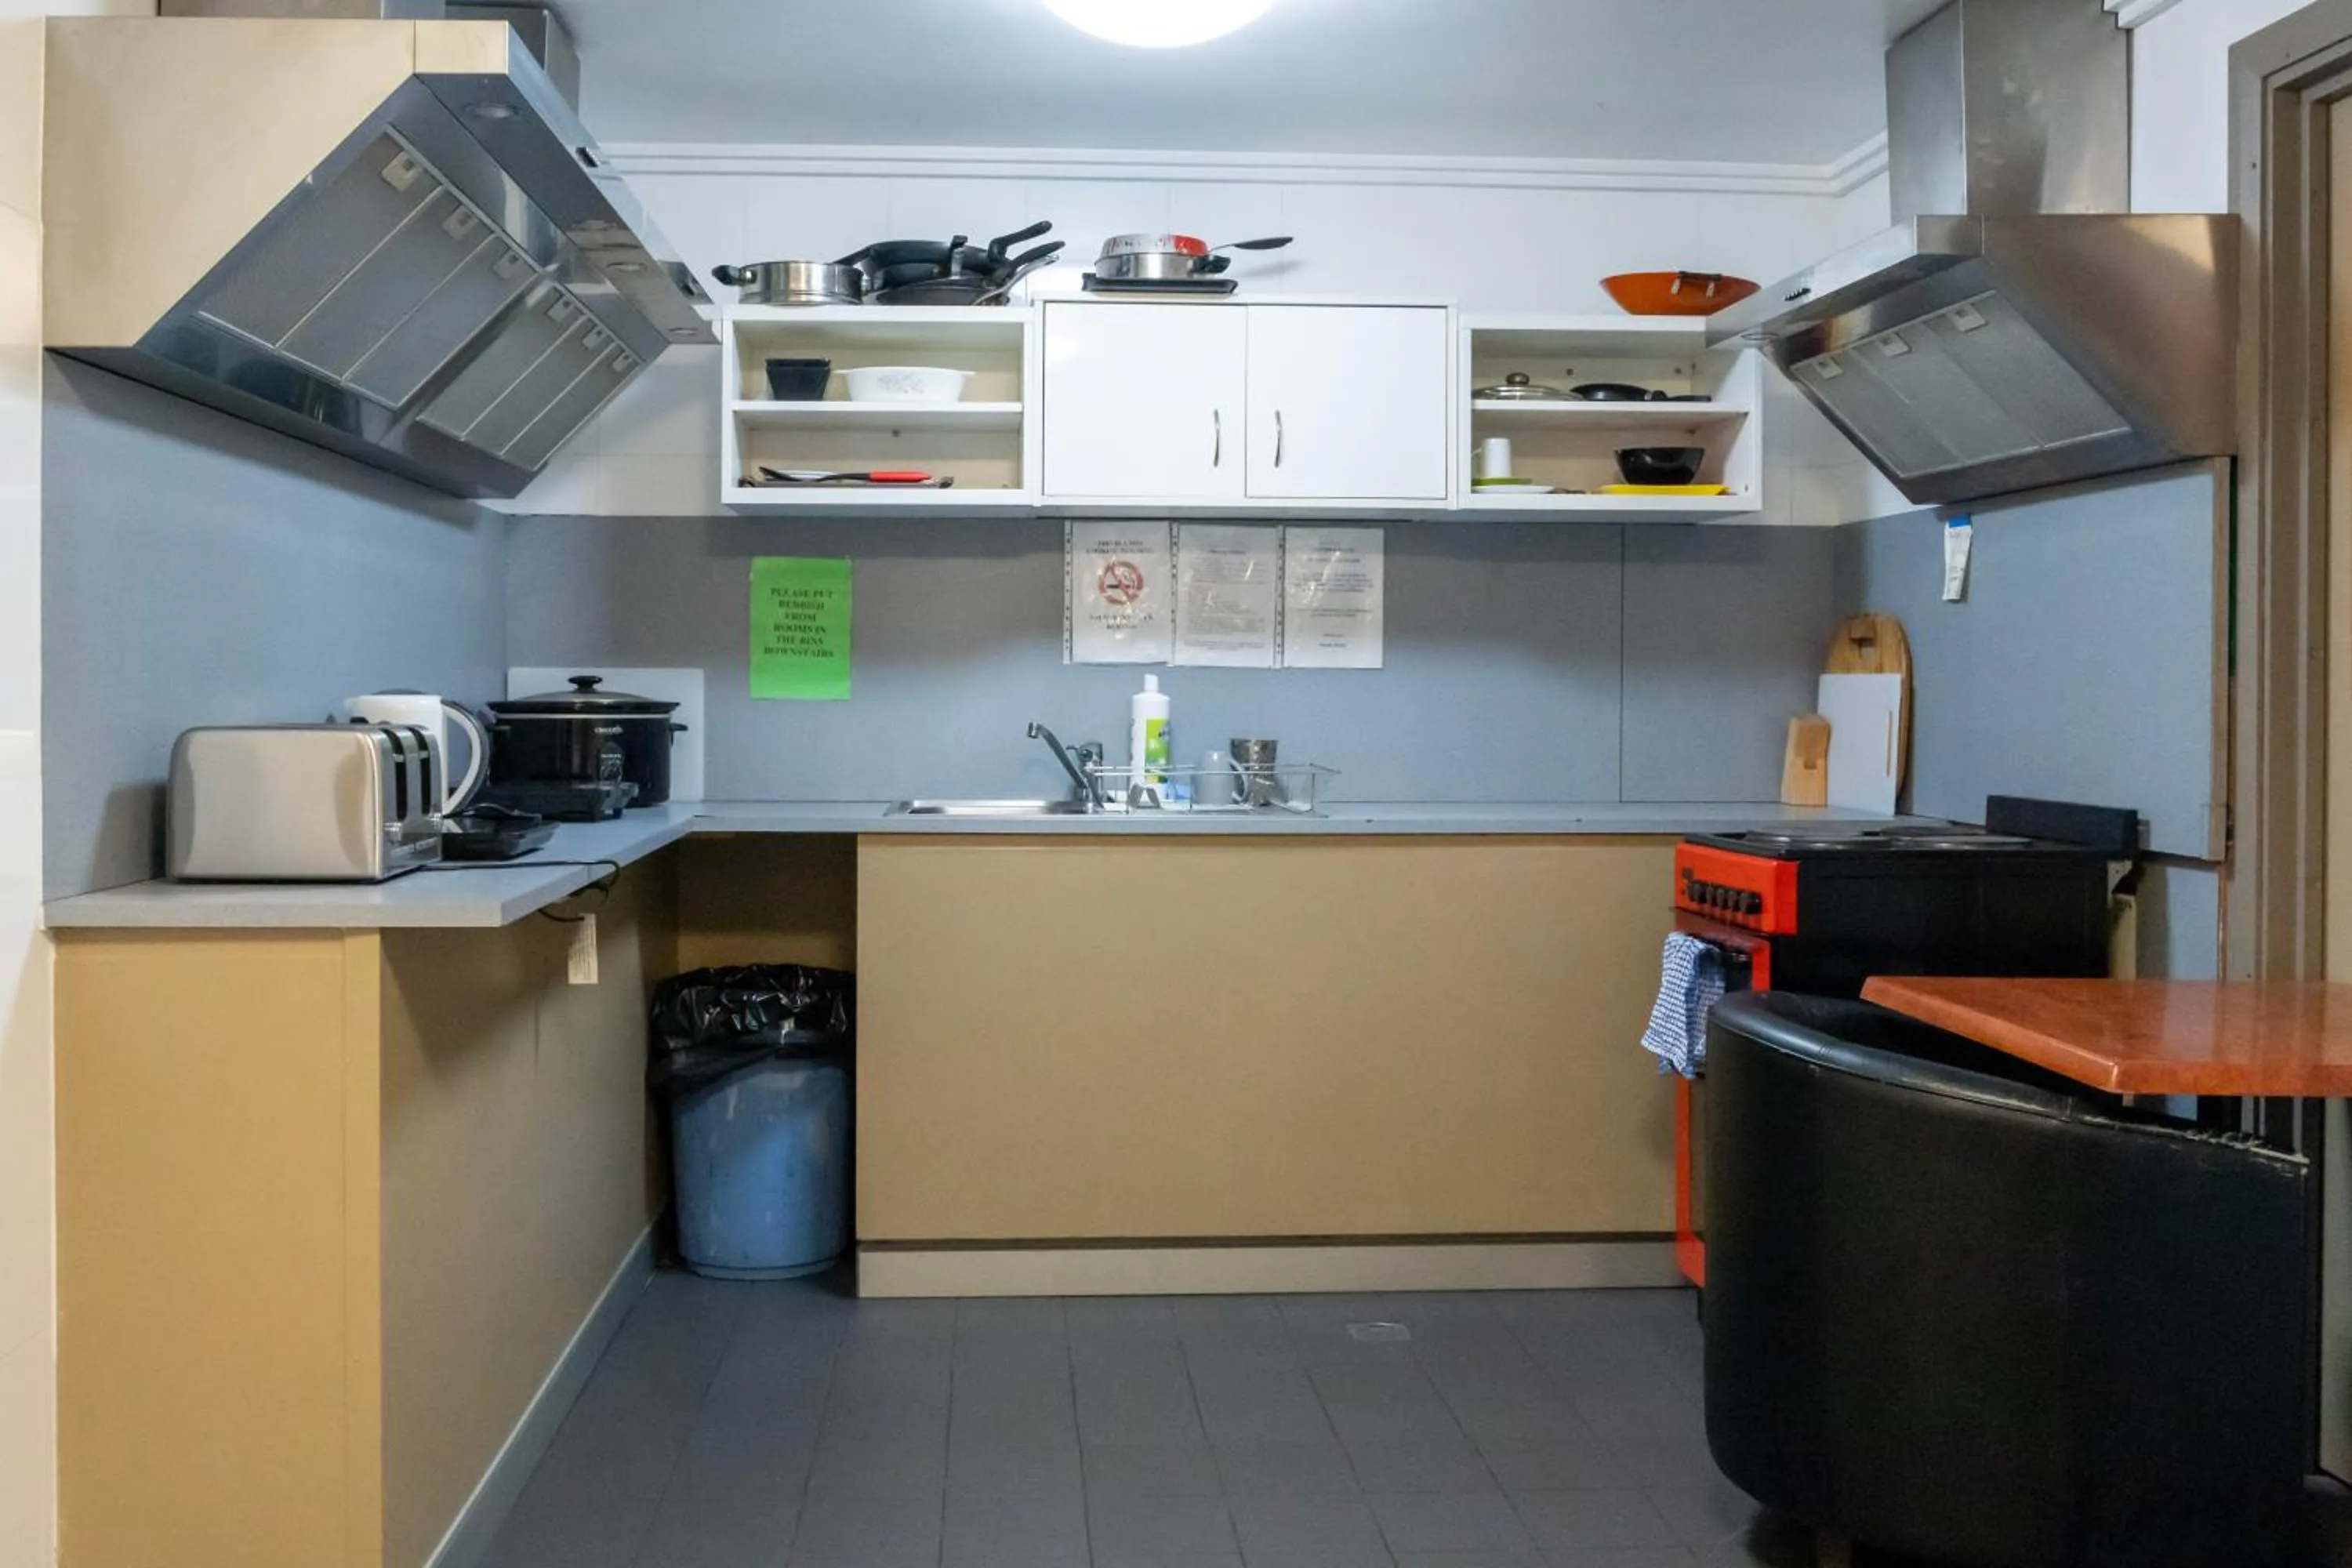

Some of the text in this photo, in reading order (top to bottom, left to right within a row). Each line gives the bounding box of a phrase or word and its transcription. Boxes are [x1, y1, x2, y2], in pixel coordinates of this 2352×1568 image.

[771, 587, 833, 600] PLEASE PUT
[779, 600, 824, 611] RUBBISH
[785, 612, 816, 622] FROM
[773, 623, 813, 633] ROOMS
[776, 635, 824, 645] THE BINS
[764, 647, 834, 658] DOWNSTAIRS
